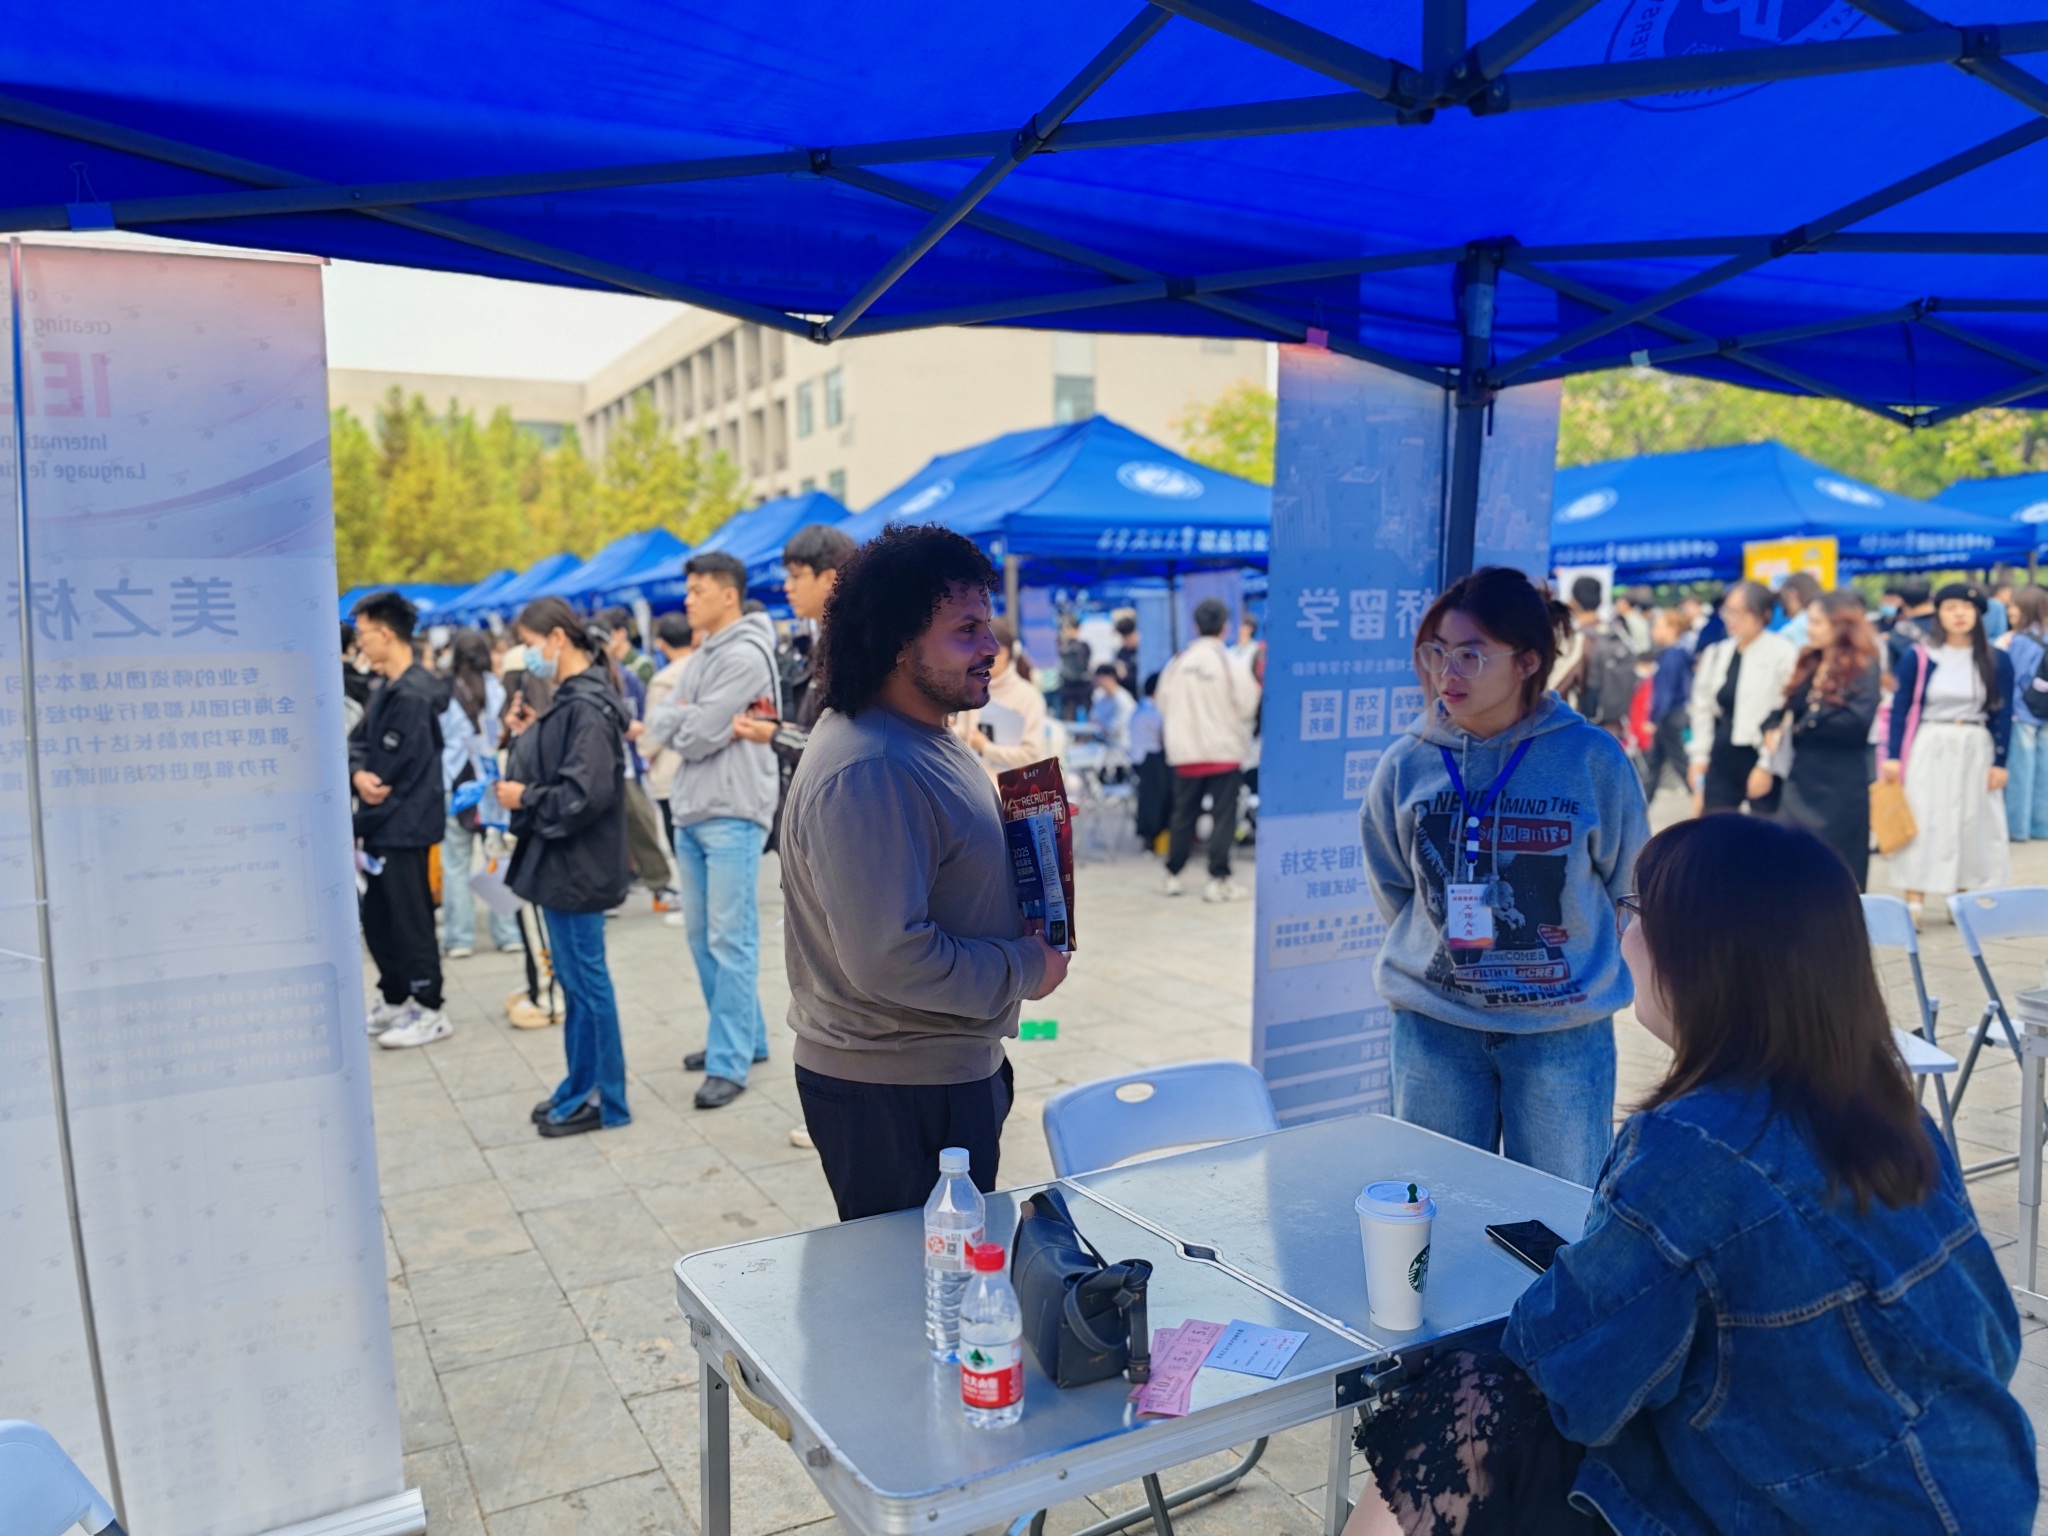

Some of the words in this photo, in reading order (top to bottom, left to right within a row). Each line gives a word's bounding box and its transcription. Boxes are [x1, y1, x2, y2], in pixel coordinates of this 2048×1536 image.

[1021, 791, 1049, 807] RECRUIT
[1502, 797, 1548, 815] MIND
[1550, 796, 1580, 815] THE
[1013, 846, 1030, 859] 2025
[1505, 950, 1546, 961] COMES
[1472, 967, 1509, 978] FILTHY
